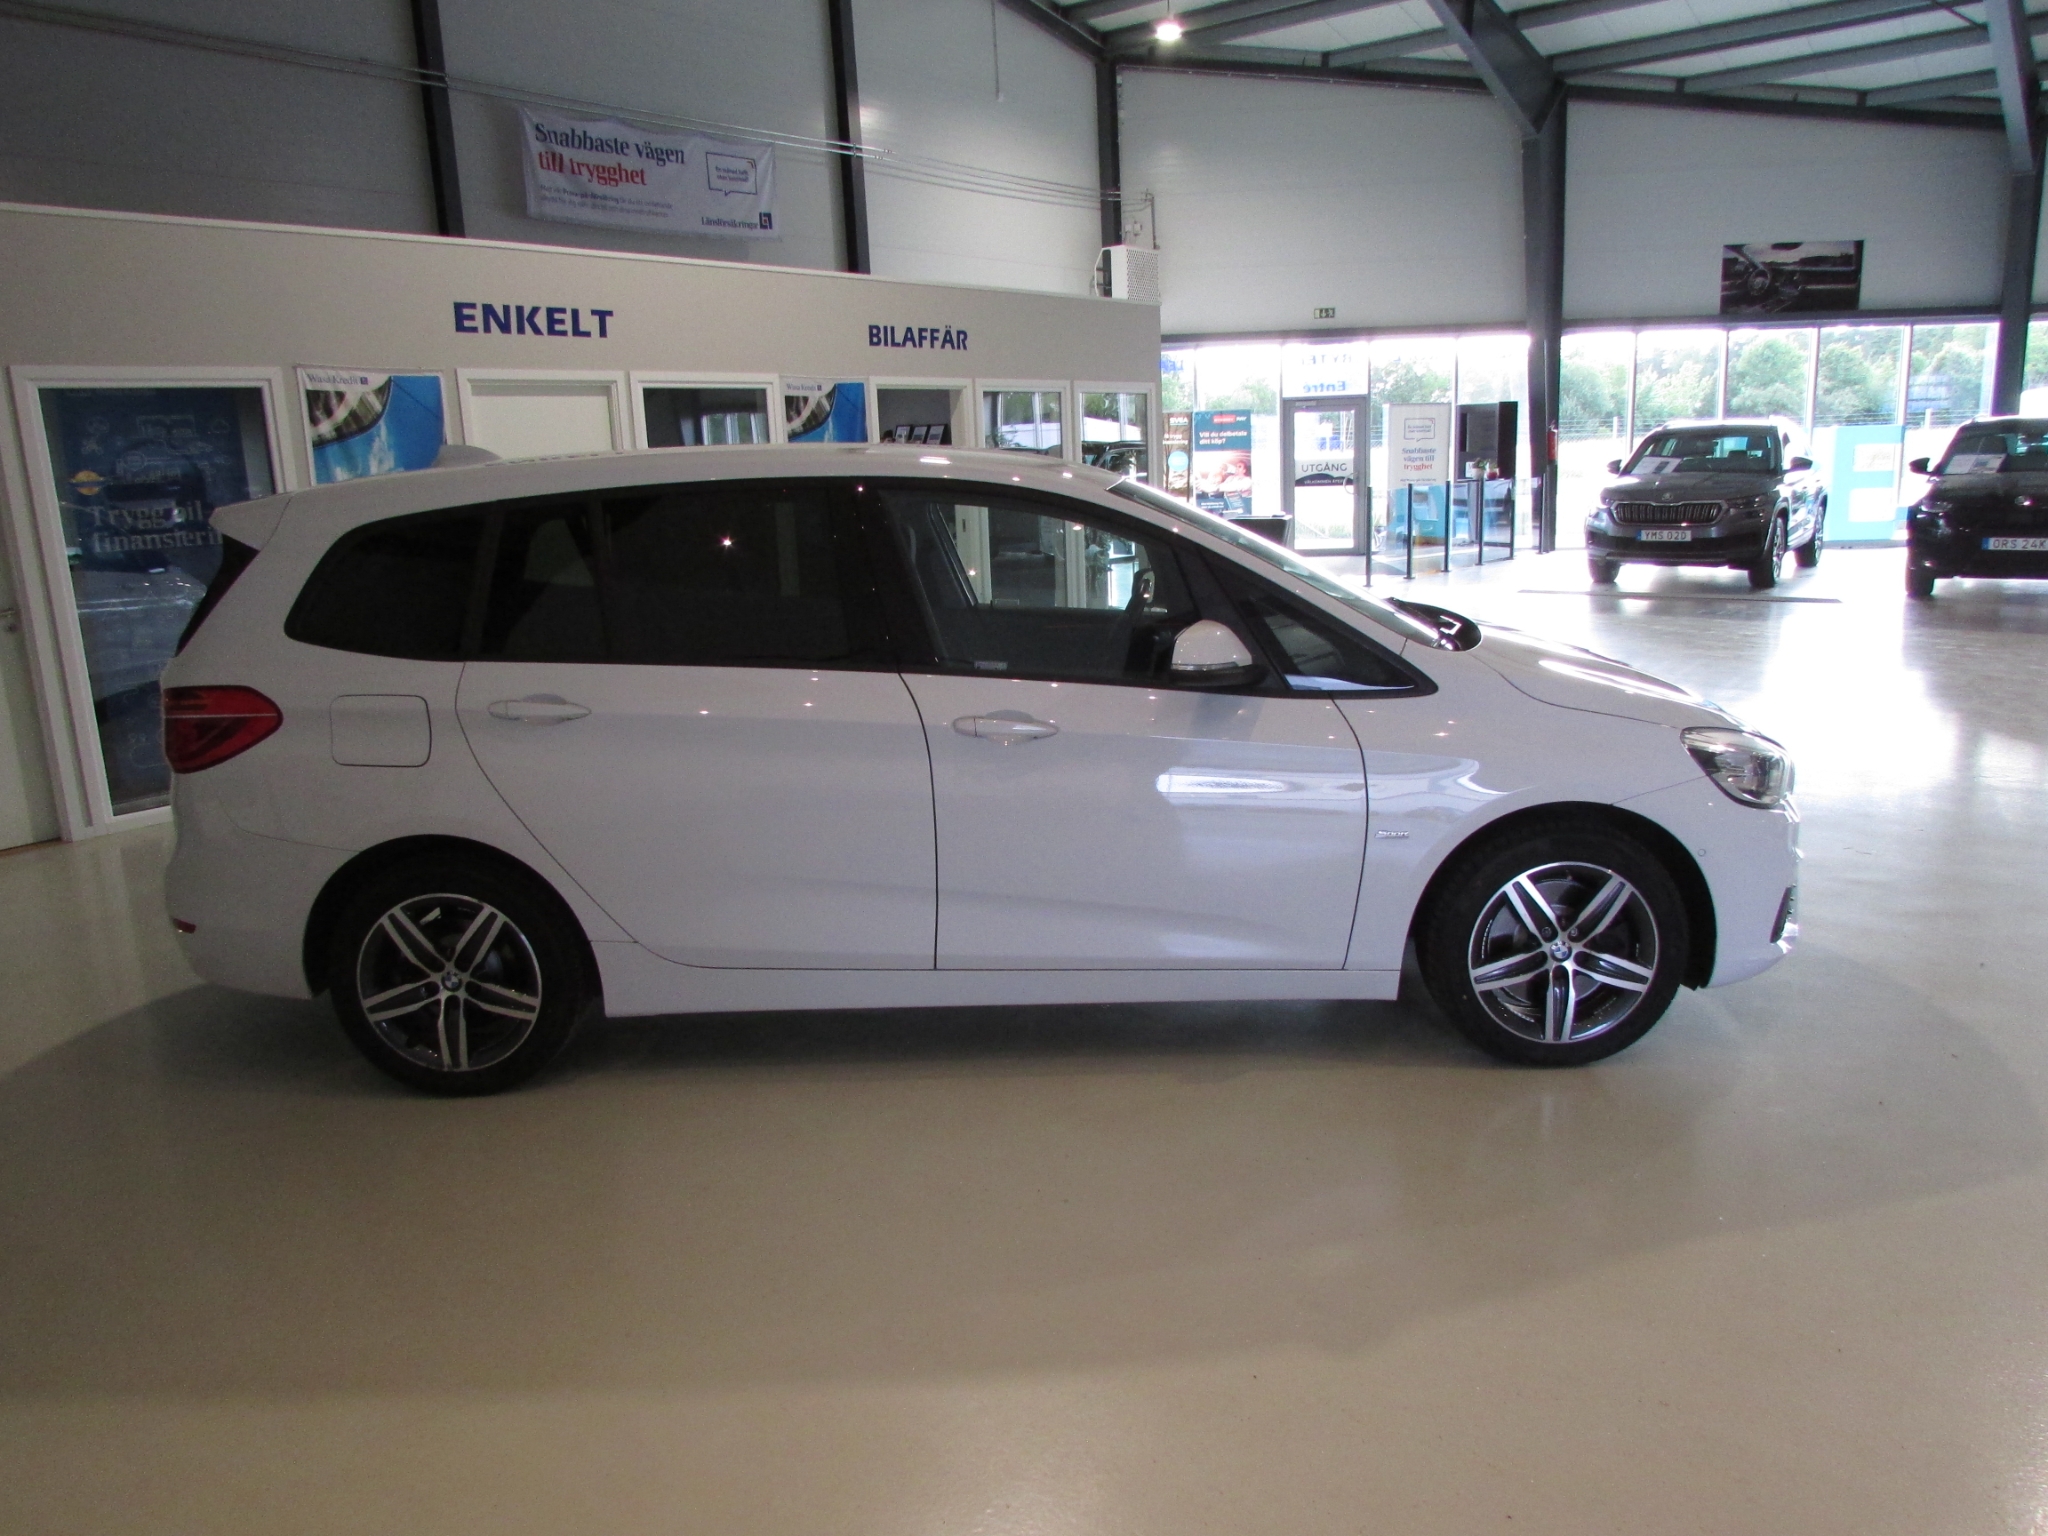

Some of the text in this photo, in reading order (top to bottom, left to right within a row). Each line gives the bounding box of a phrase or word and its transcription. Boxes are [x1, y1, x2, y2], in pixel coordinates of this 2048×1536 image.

[535, 123, 685, 167] Snabbaste vägen
[538, 151, 647, 188] till trygghet
[453, 301, 614, 339] ENKELT
[868, 324, 968, 351] BILAFFÄR
[1301, 462, 1348, 473] UTGÅNG
[1645, 531, 1664, 540] YMS
[2021, 539, 2047, 549] 24K
